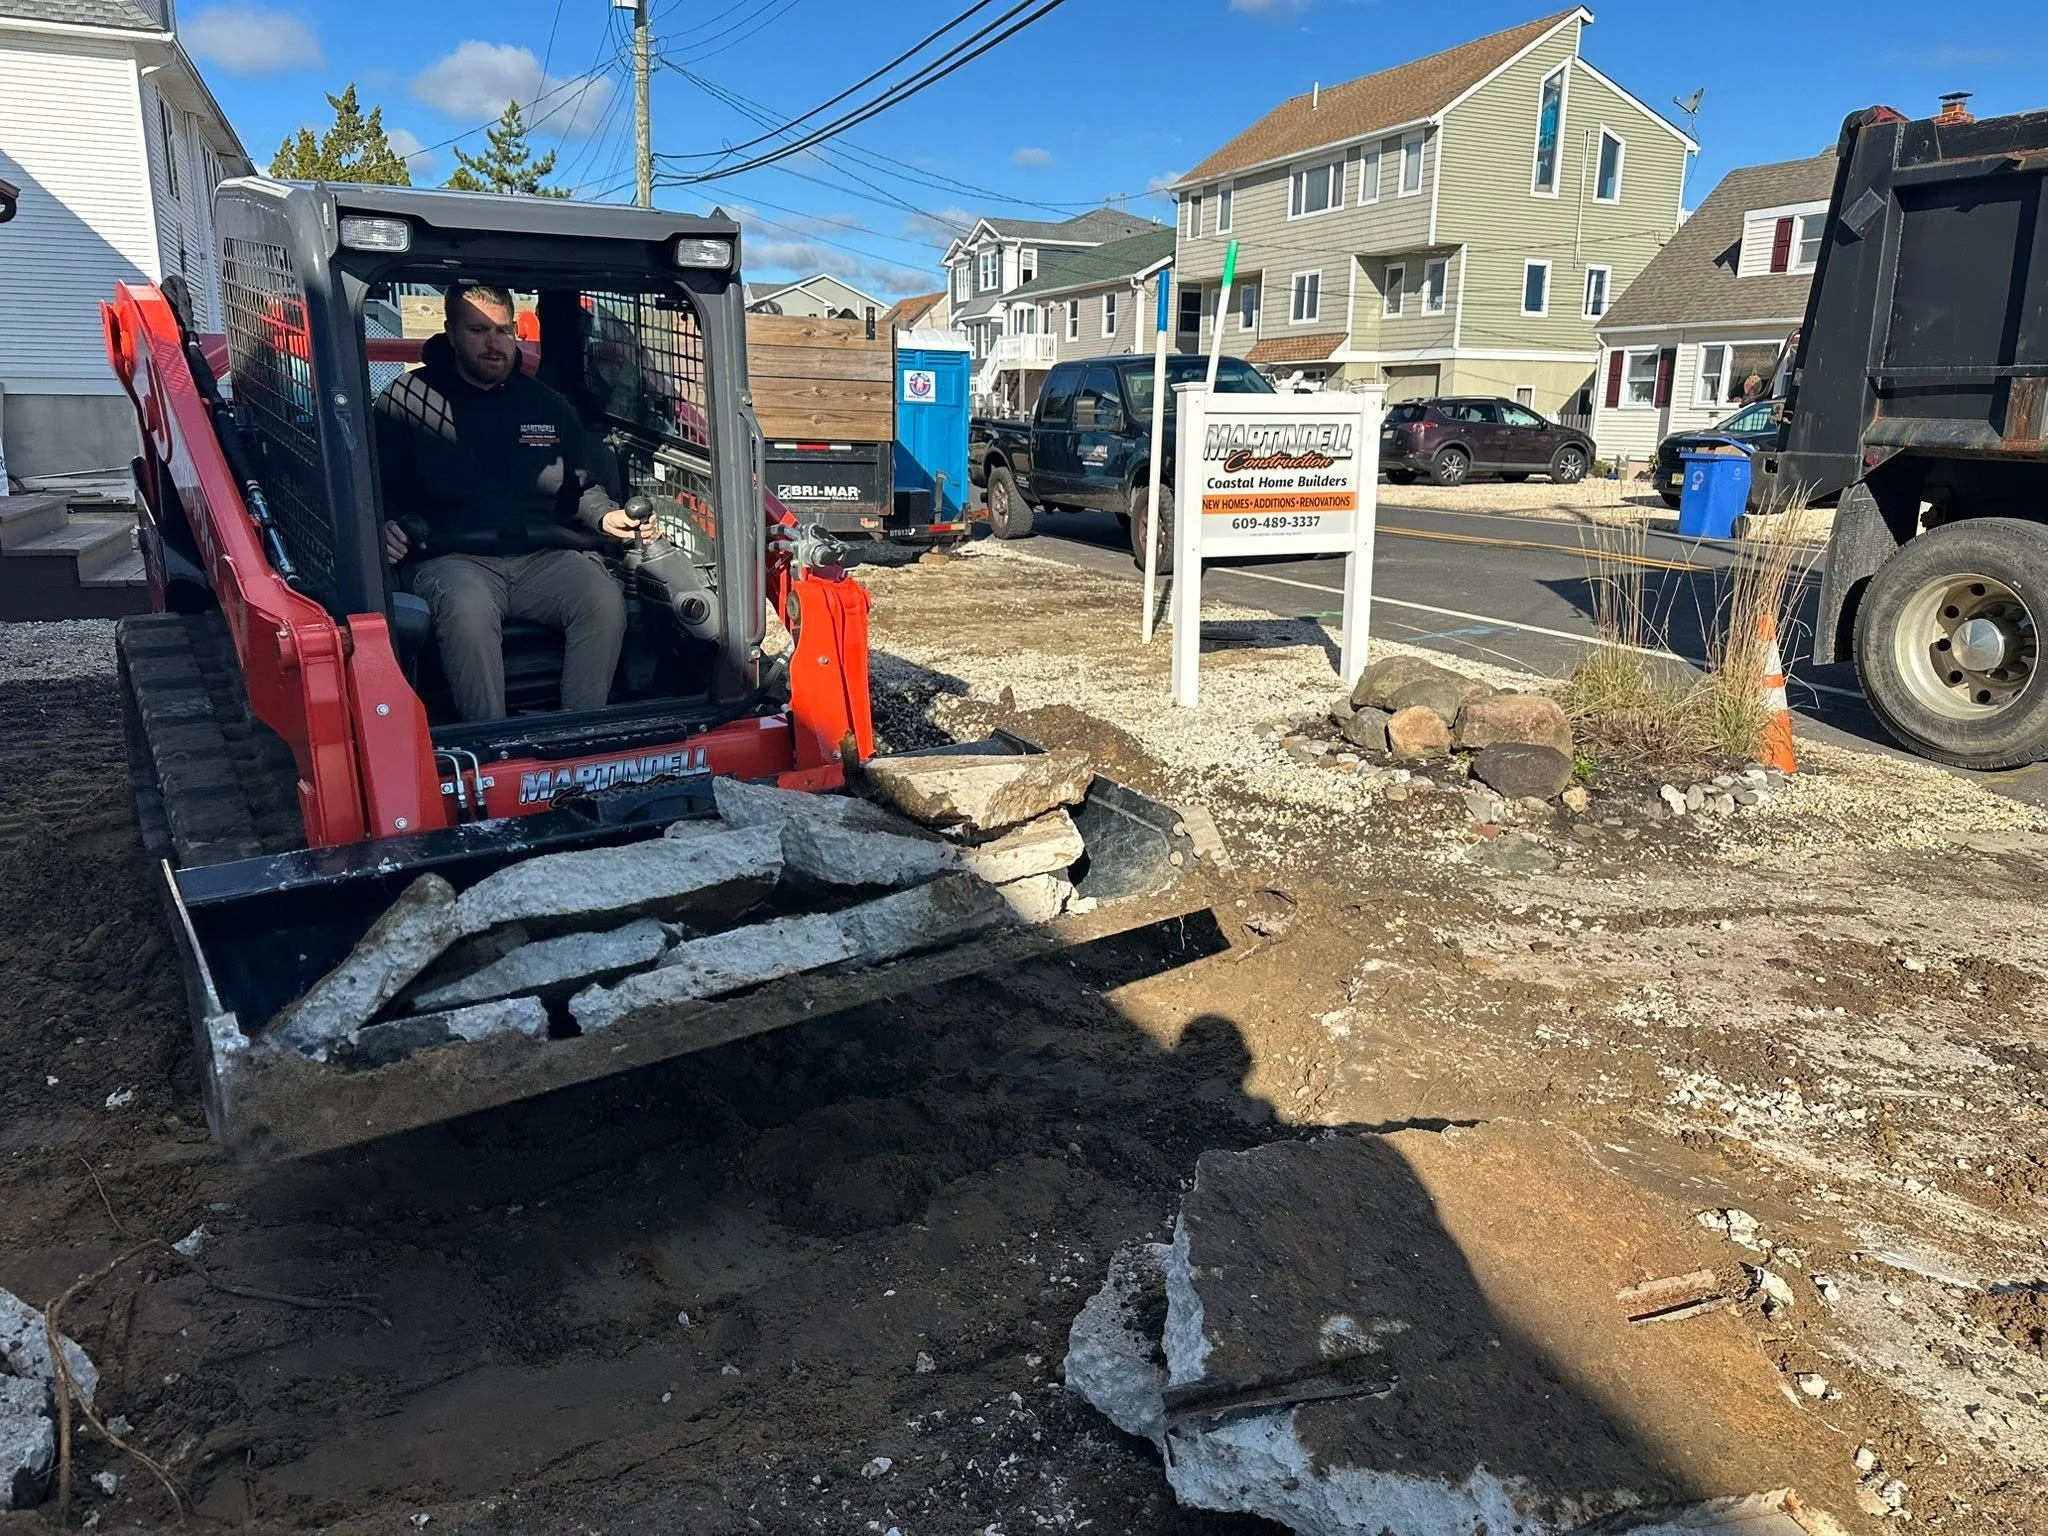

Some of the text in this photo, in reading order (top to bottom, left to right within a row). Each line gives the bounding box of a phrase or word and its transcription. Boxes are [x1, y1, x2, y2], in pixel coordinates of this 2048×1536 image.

[1203, 423, 1353, 461] MARTINDELL
[1223, 450, 1334, 473] Construction
[1207, 475, 1347, 489] Coastal Home Builders
[1202, 499, 1219, 510] NEW
[1232, 516, 1320, 529] 609-489-3337
[520, 746, 711, 805] MARTINDELL
